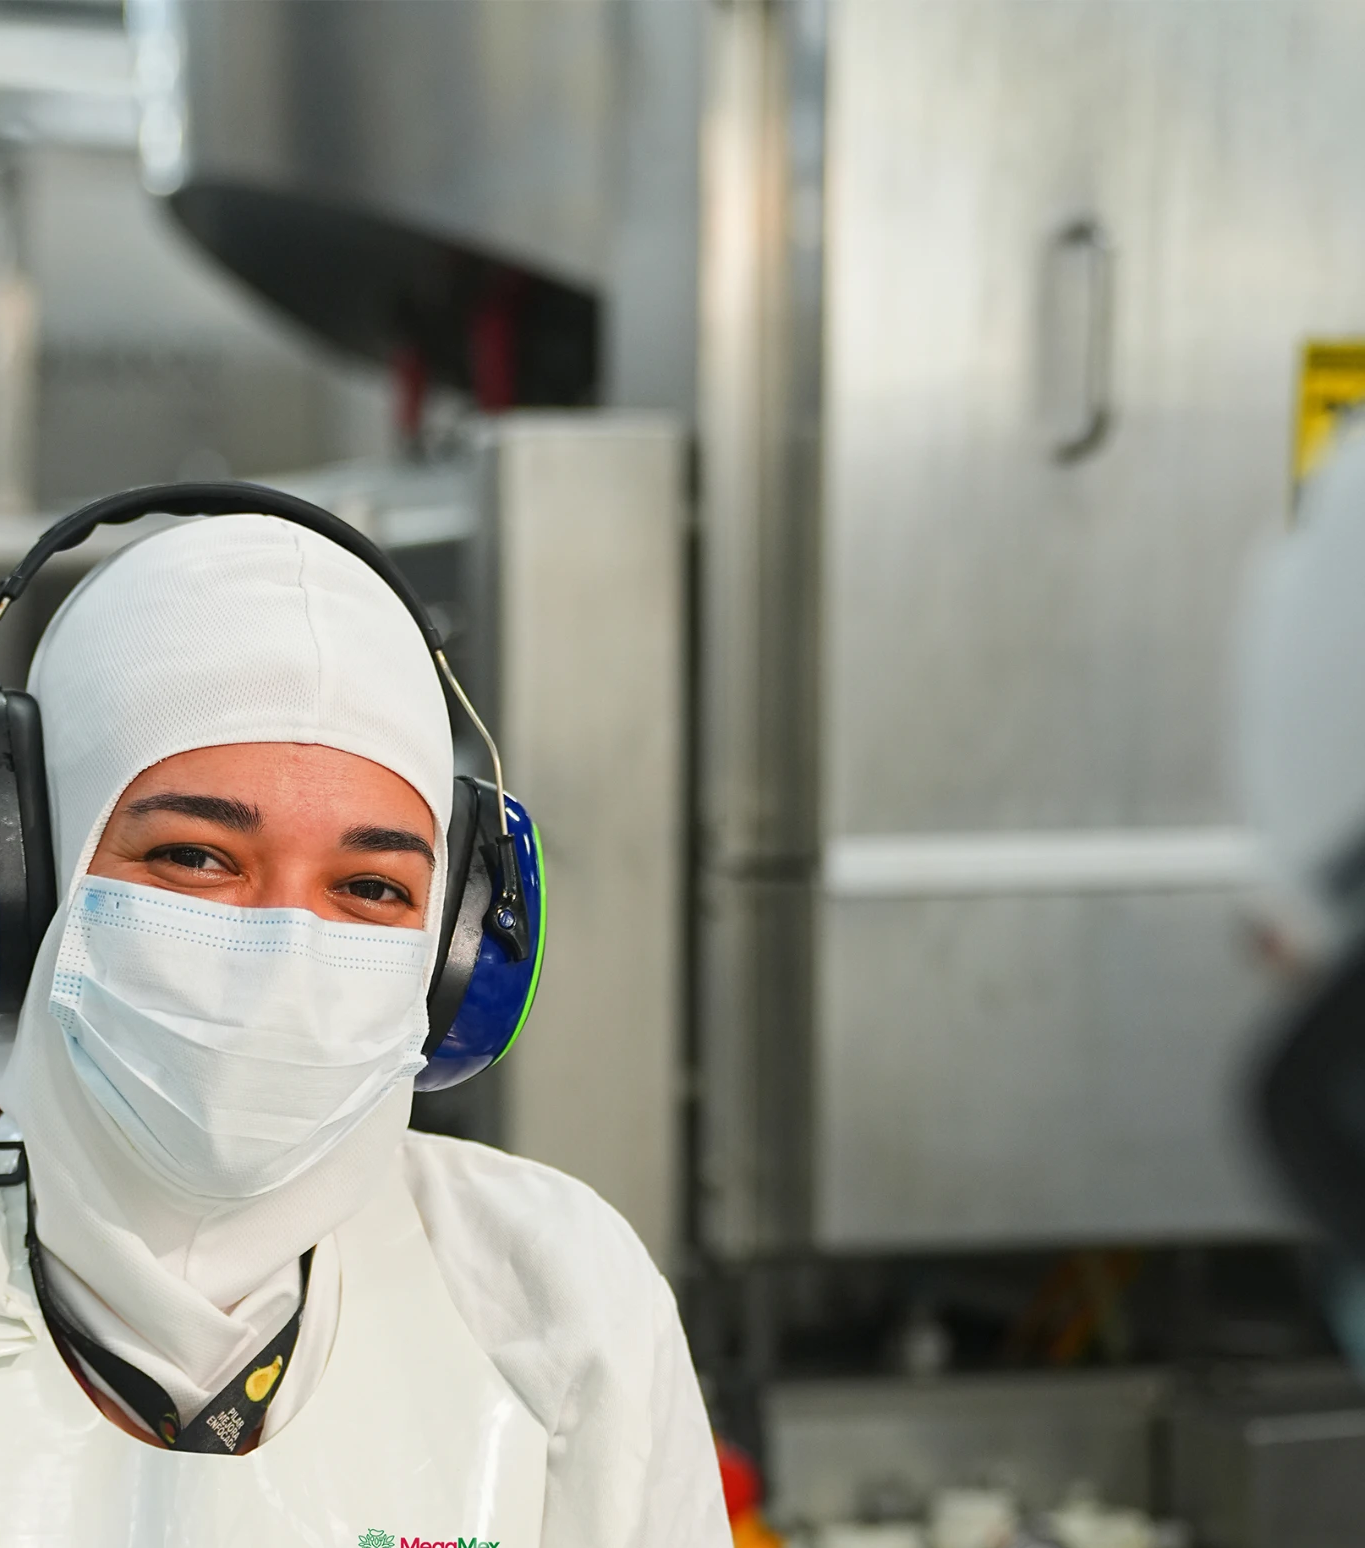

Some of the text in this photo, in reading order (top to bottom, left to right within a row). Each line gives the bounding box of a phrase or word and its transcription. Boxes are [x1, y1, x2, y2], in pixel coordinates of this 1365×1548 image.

[206, 1415, 236, 1452] ENFOCADA
[217, 1411, 240, 1441] MEJORA
[228, 1408, 245, 1430] PILAR
